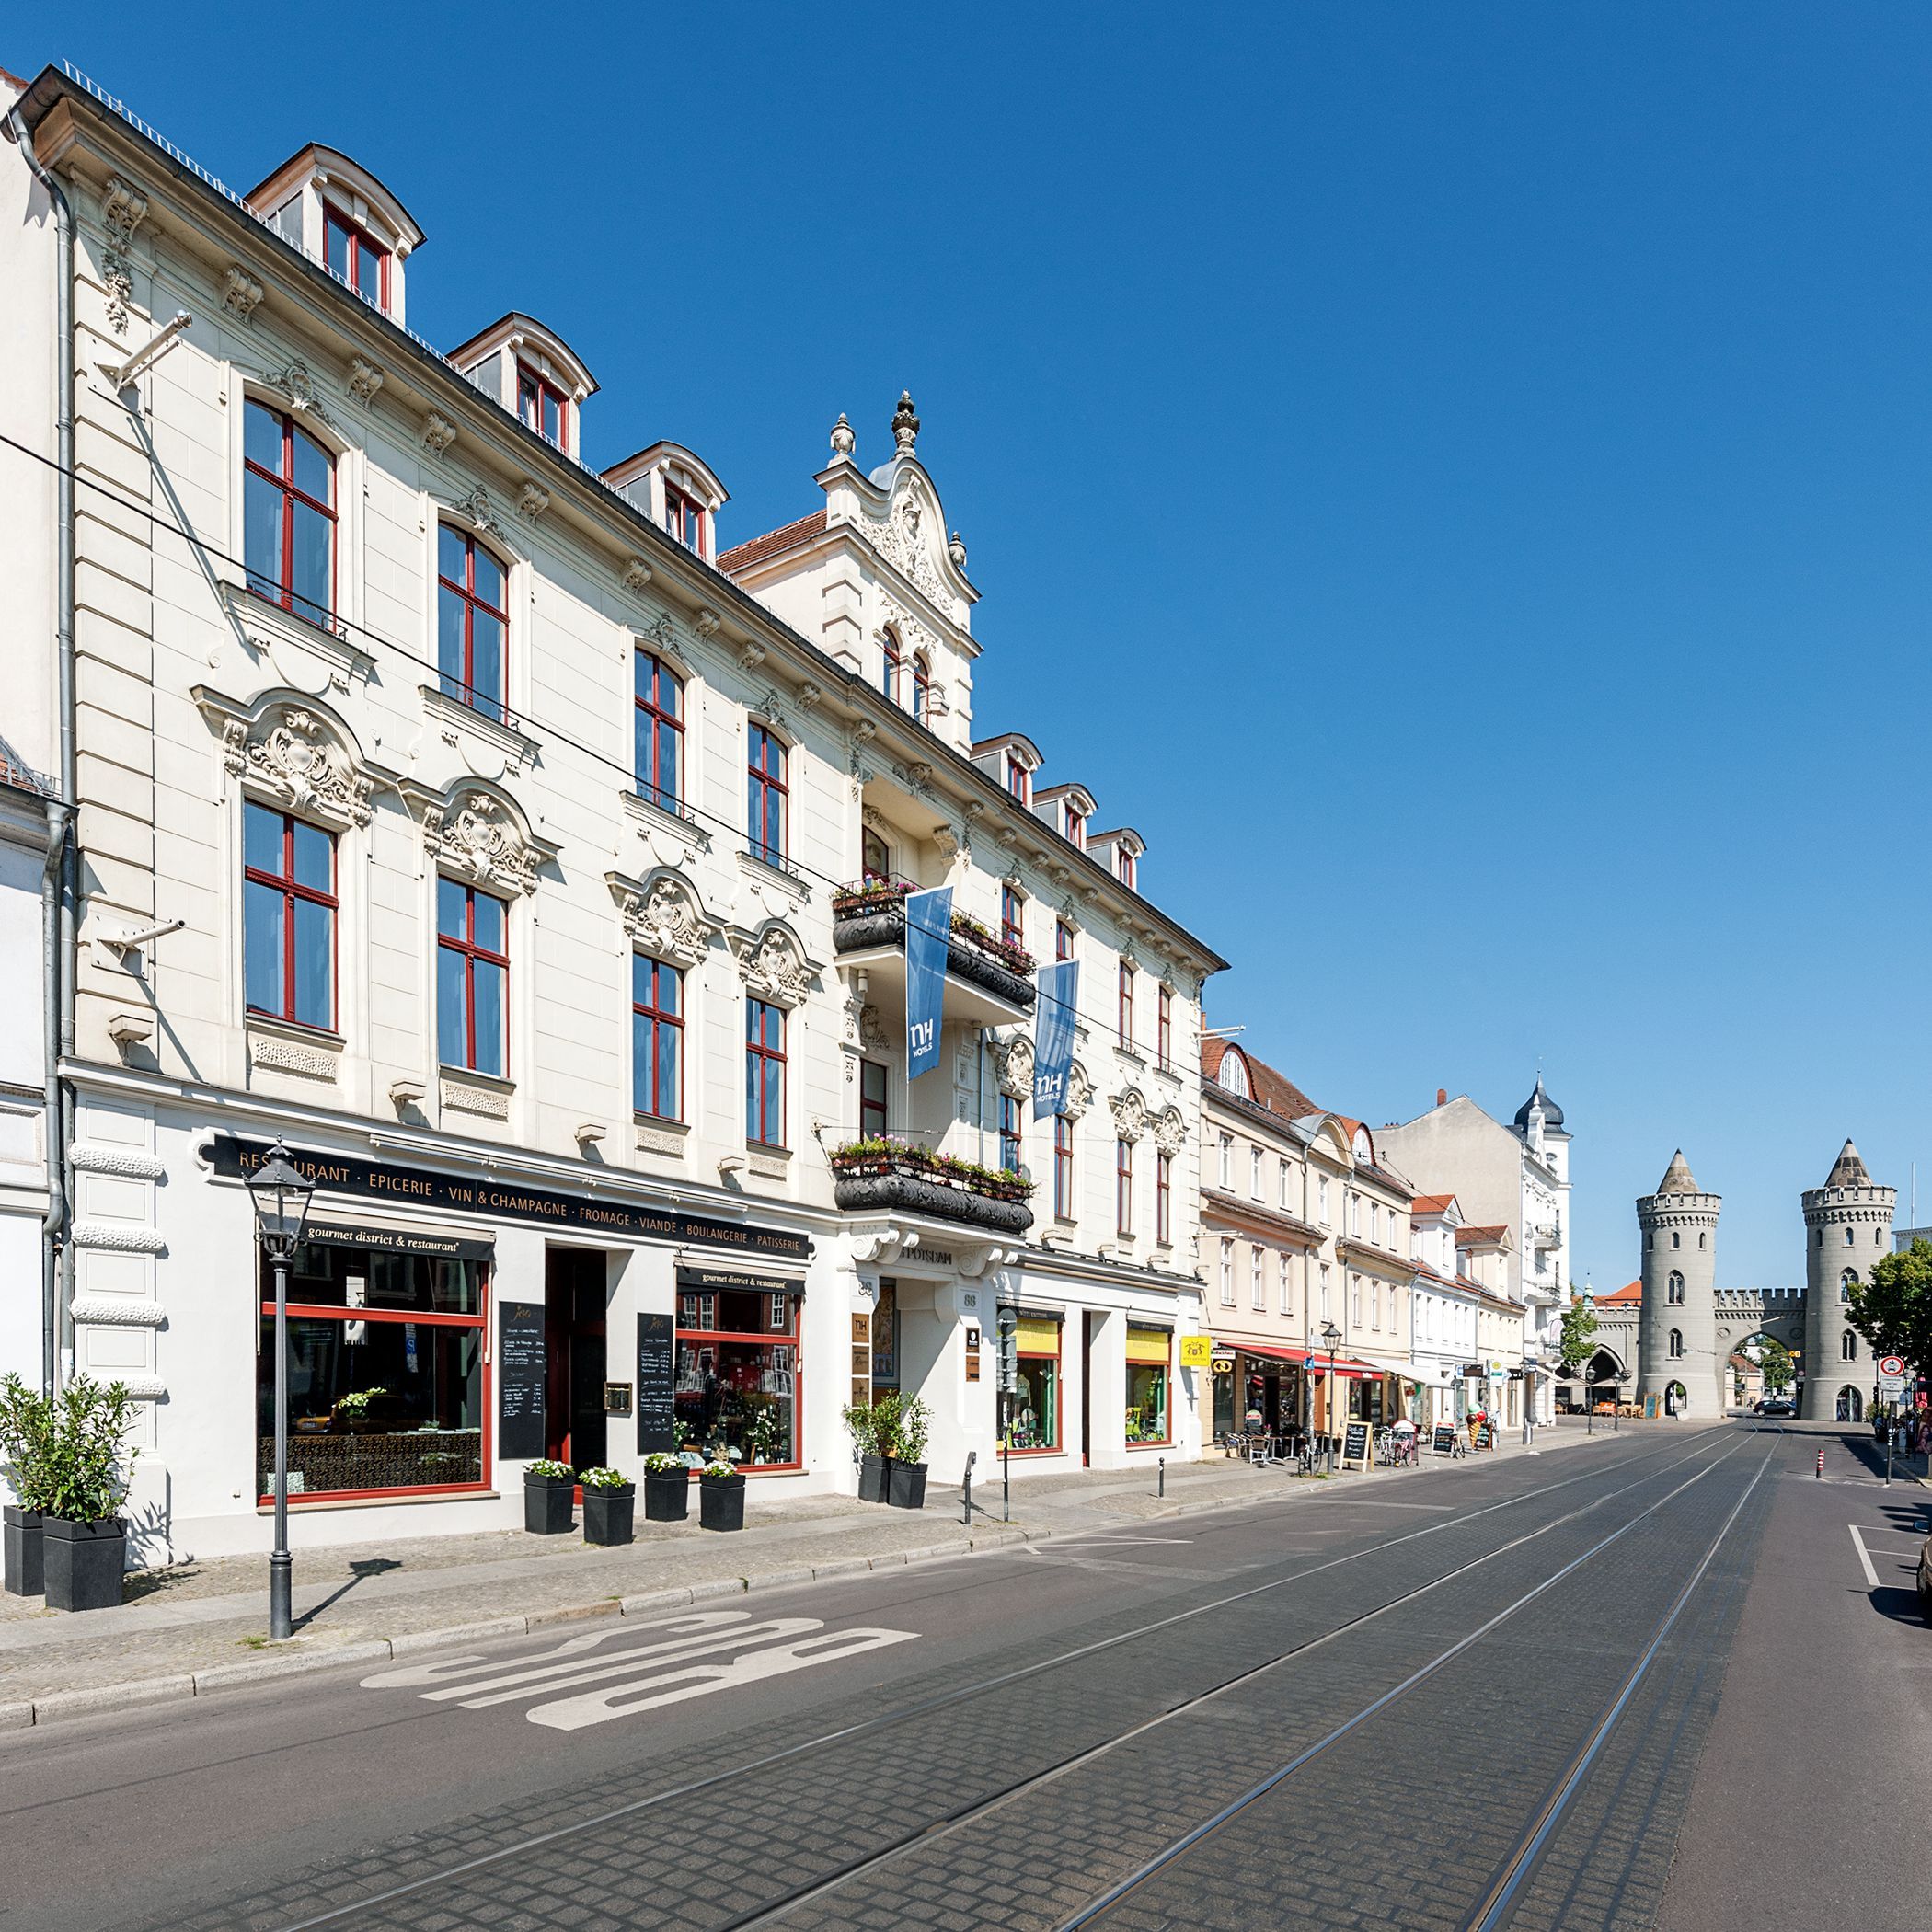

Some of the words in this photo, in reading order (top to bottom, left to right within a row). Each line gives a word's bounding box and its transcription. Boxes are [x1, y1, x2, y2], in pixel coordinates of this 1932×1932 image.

[913, 1042, 933, 1058] HOTELS
[1036, 1092, 1061, 1103] HOTELS
[239, 1152, 350, 1183] RESURANT
[369, 1174, 432, 1196] EPICERIE
[449, 1187, 472, 1202] VIN
[477, 1190, 487, 1204] &
[490, 1193, 567, 1217] CHAMPAGNE
[580, 1208, 630, 1226] FROMAGE
[639, 1216, 677, 1233] VIANDE
[686, 1224, 748, 1244] BOULANGERIE
[757, 1236, 799, 1252] PATISSERIE
[307, 1226, 353, 1241] gourmet
[355, 1230, 393, 1245] district
[395, 1236, 405, 1247] &
[906, 1248, 952, 1265] POTSDAM
[702, 1272, 727, 1284] gourmet
[728, 1275, 748, 1285] district
[749, 1278, 755, 1286] &
[964, 1294, 976, 1307] 88
[359, 1610, 924, 1731] BUS
